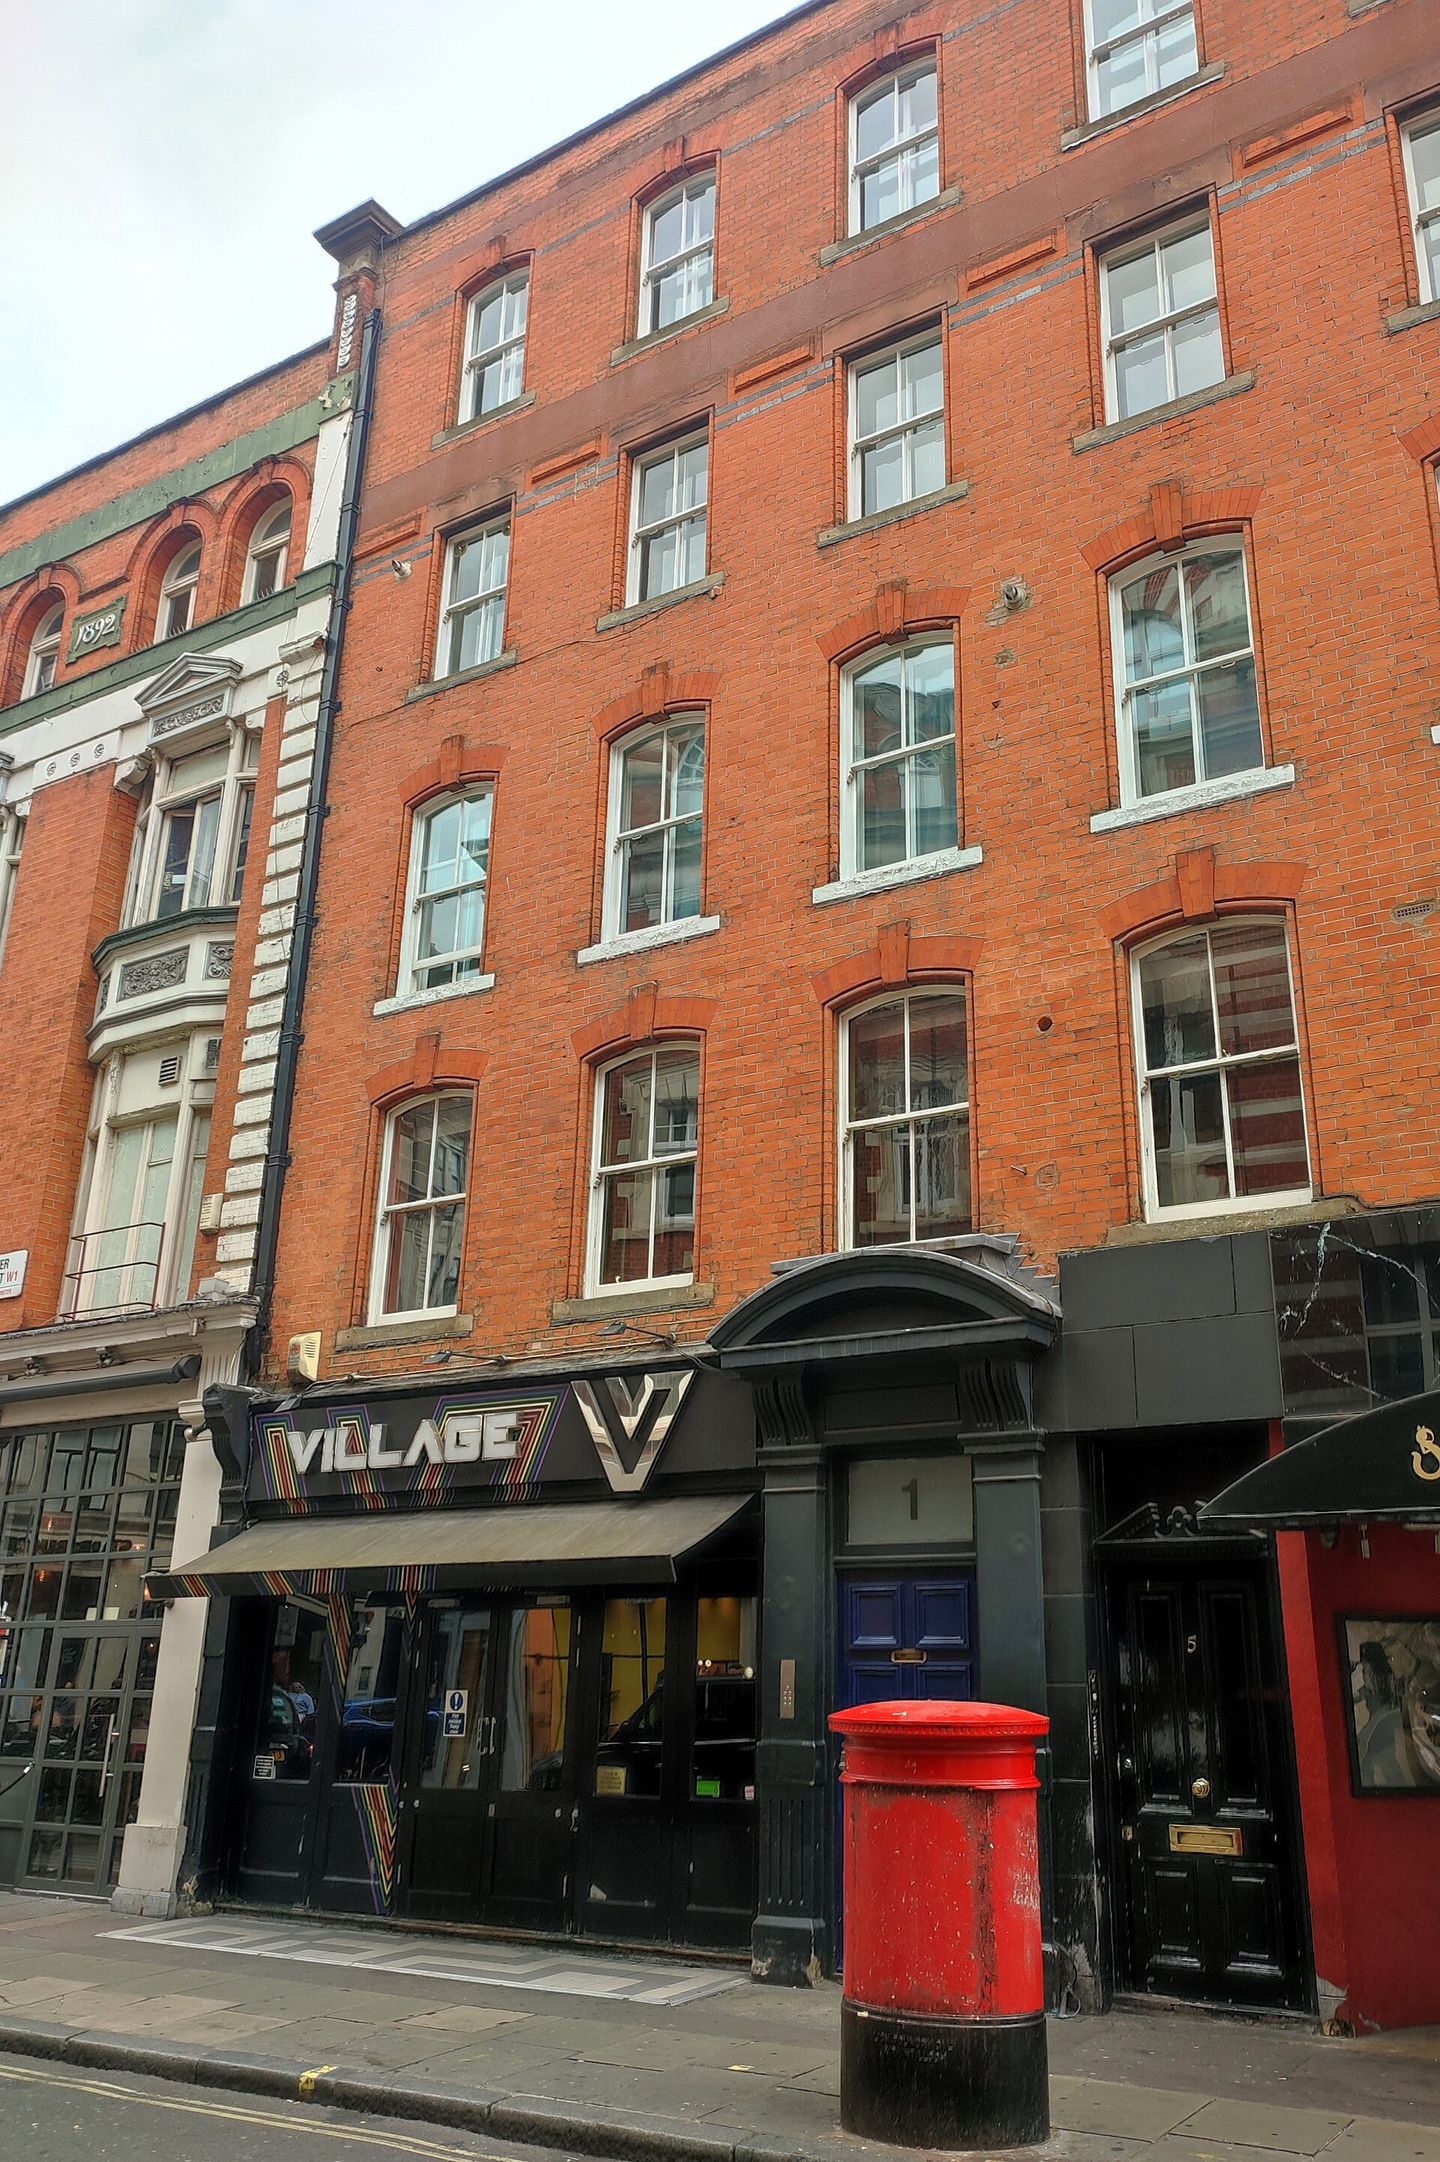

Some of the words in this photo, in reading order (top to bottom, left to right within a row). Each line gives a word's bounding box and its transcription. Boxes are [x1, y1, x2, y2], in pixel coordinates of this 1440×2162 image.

[73, 613, 116, 650] 1892
[6, 1270, 18, 1283] W1
[287, 1412, 526, 1475] VILLAGE
[900, 1477, 919, 1522] 1
[1187, 1634, 1197, 1654] 5
